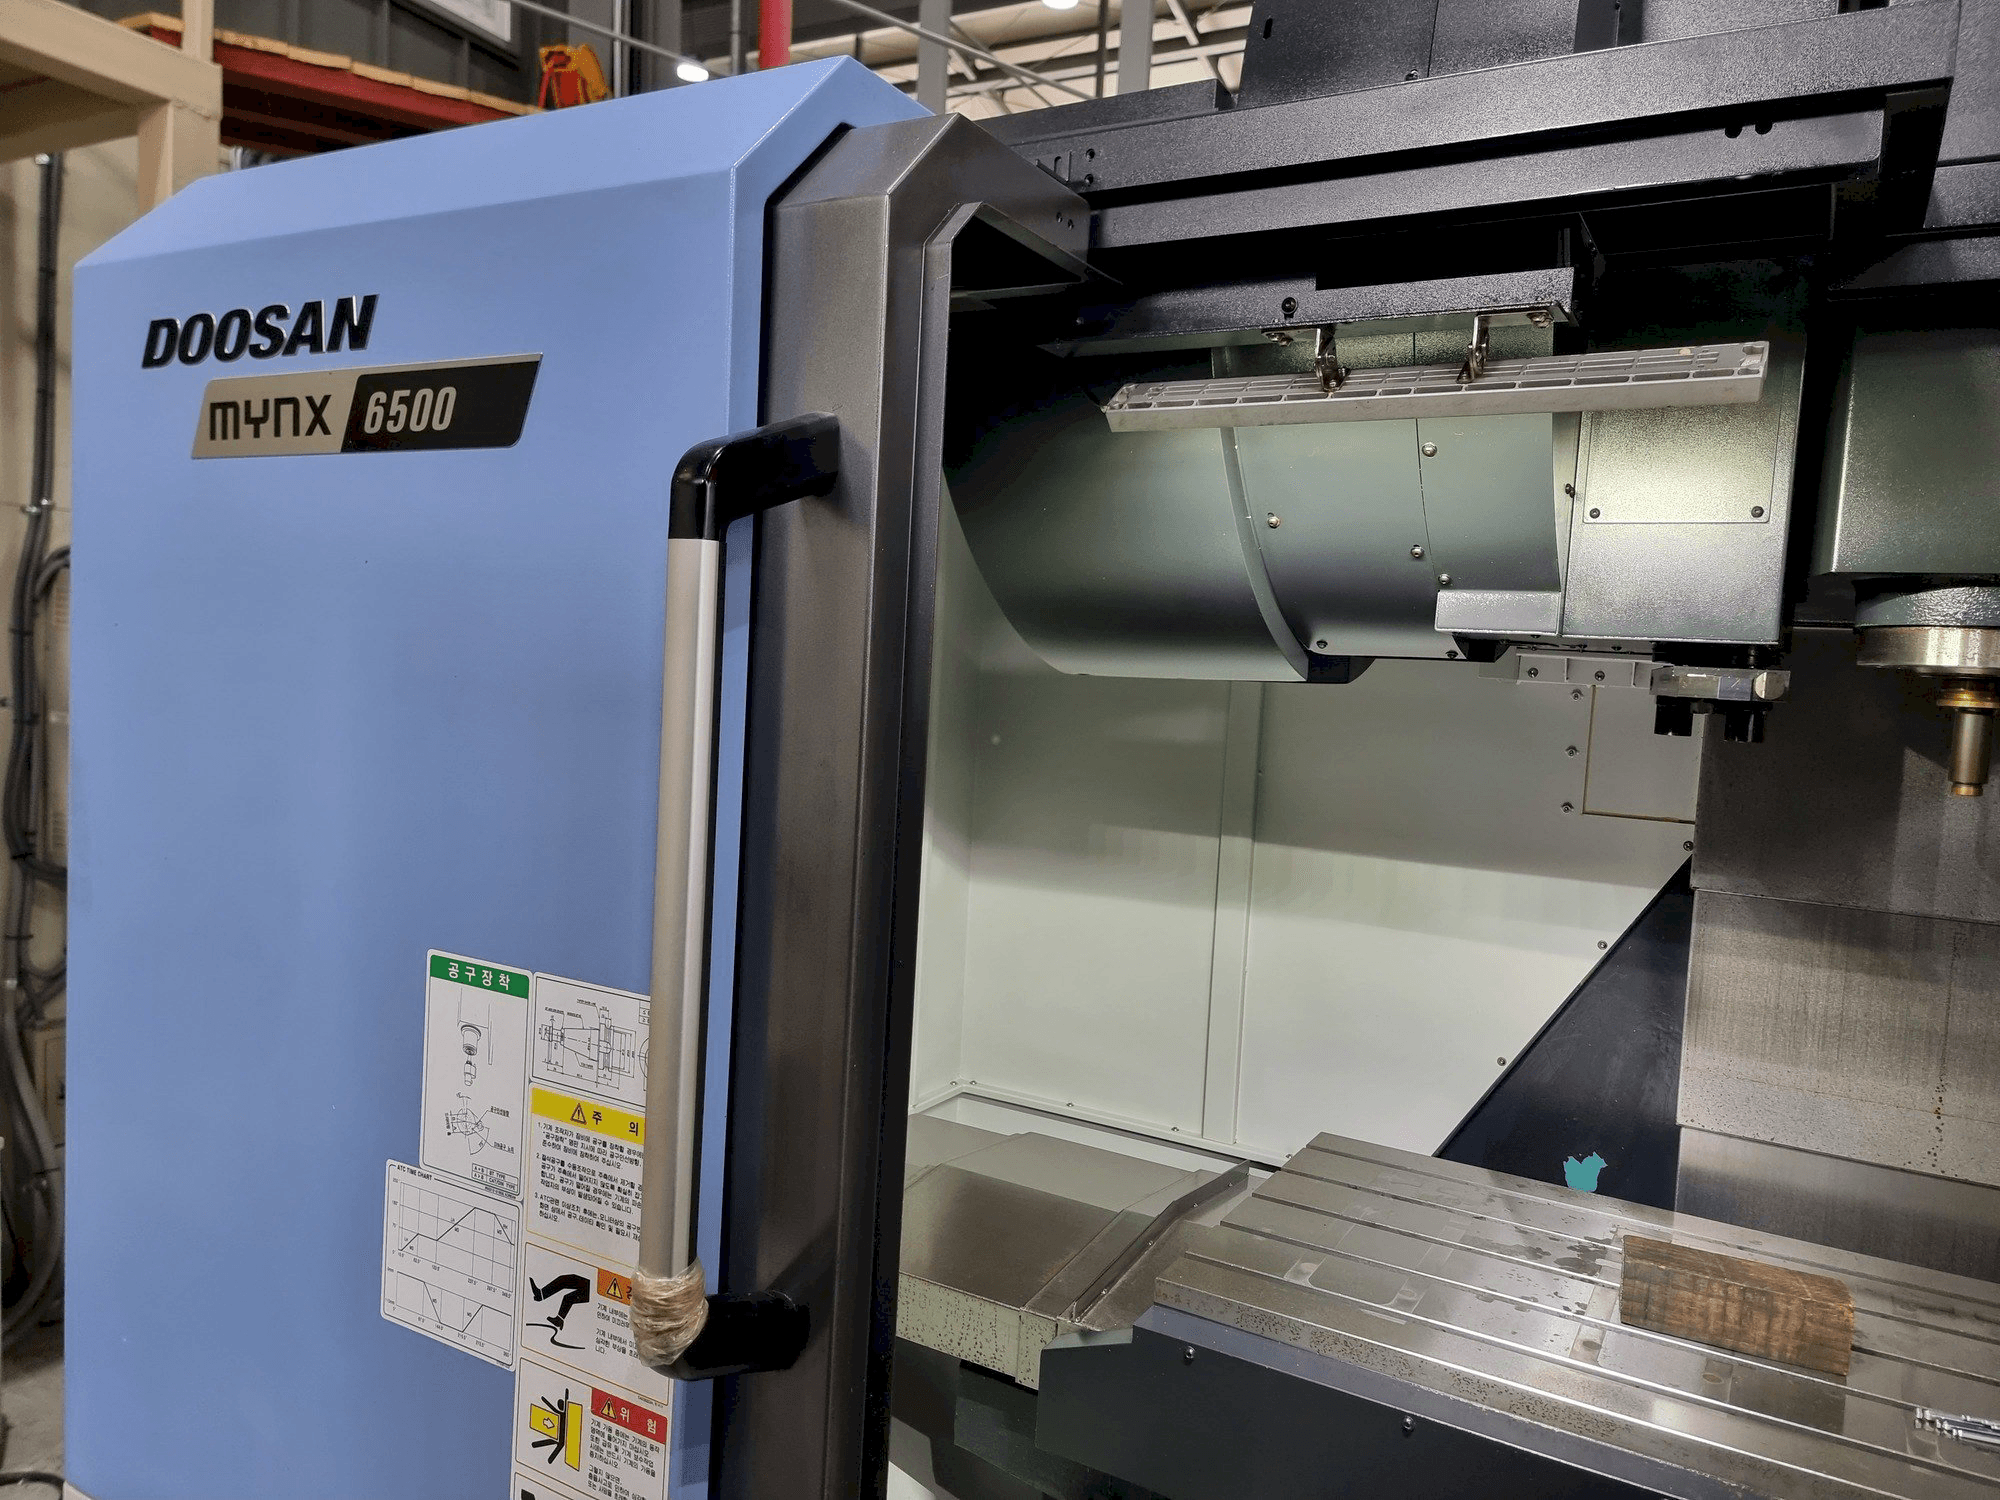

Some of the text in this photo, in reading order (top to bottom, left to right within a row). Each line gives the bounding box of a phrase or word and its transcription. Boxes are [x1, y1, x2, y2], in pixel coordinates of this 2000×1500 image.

[142, 294, 379, 368] DOOSAN
[363, 386, 457, 434] 6500
[555, 1127, 573, 1138] 조작자가
[576, 1133, 590, 1142] 장비에
[593, 1138, 607, 1148] 공구를
[627, 1148, 643, 1159] 경우에
[581, 1143, 595, 1153] 지시에
[597, 1148, 607, 1156] 따라
[563, 1146, 578, 1155] 장비에
[580, 1151, 599, 1162] 장착하여
[418, 1171, 432, 1180] CHART
[541, 1163, 556, 1172] 공구가
[560, 1176, 574, 1187] 공구가
[615, 1194, 630, 1204] 기계의
[591, 1419, 600, 1428] 기계
[632, 1436, 647, 1448] 기계의
[622, 1448, 631, 1458] 기계
[624, 1457, 638, 1470] 기계의
